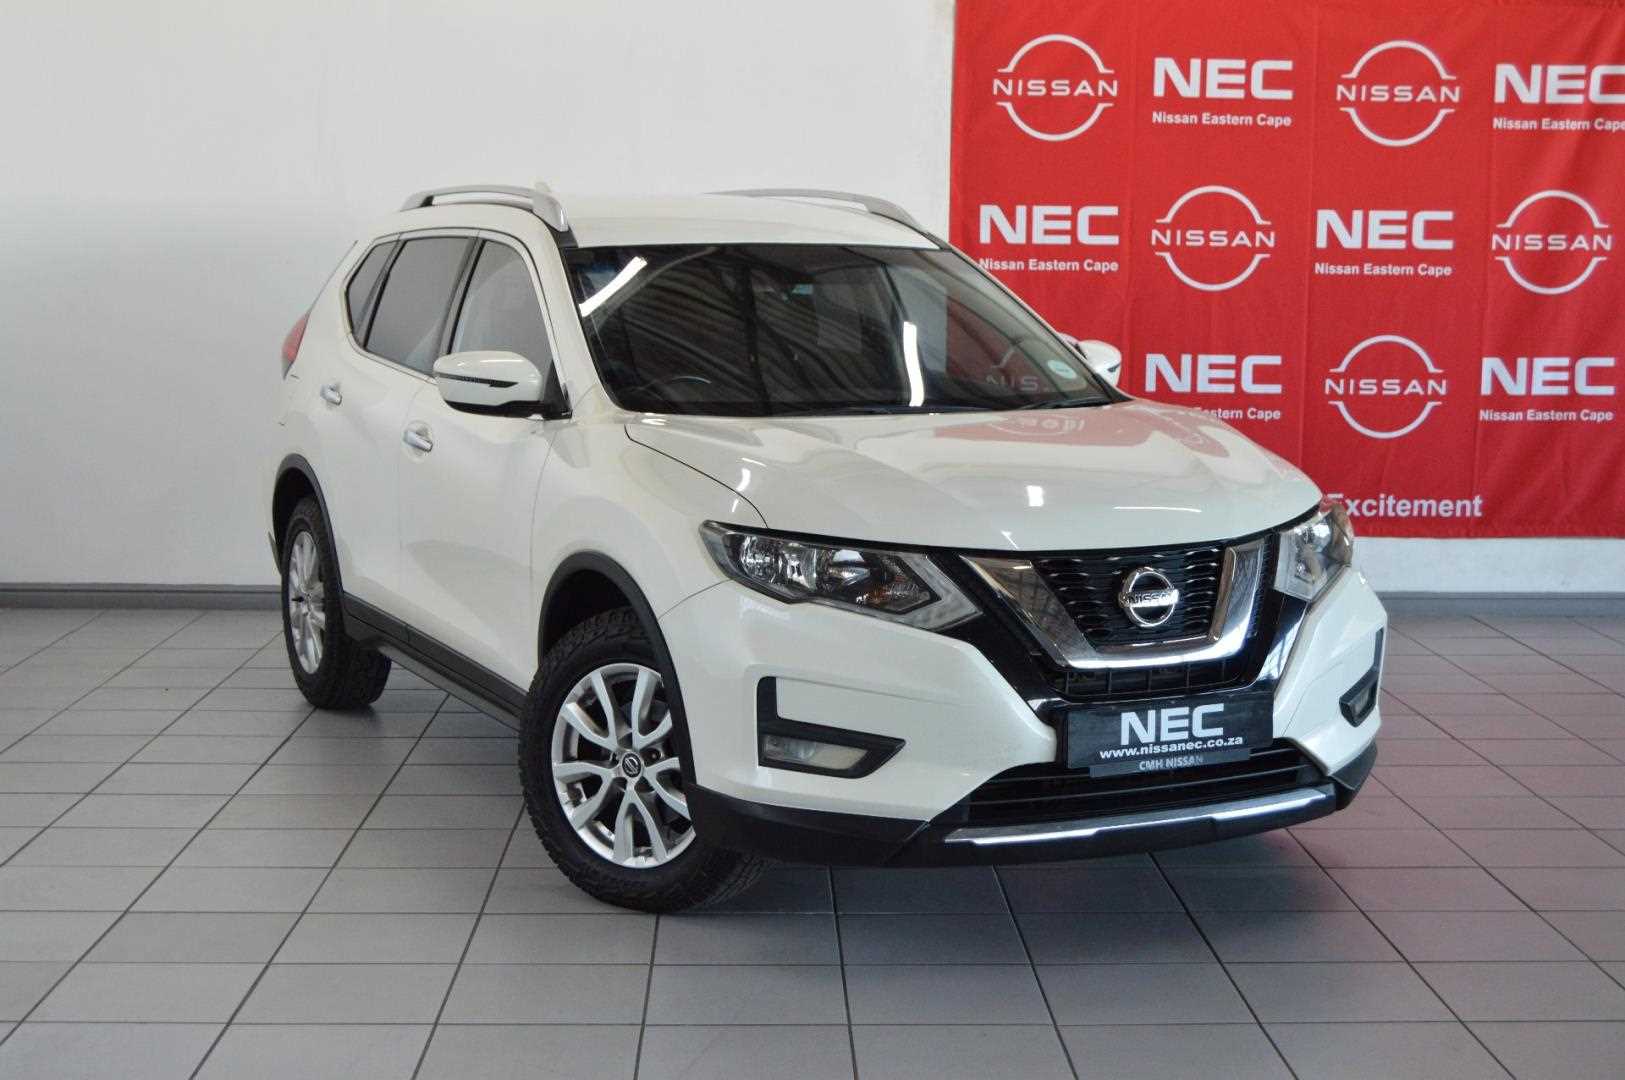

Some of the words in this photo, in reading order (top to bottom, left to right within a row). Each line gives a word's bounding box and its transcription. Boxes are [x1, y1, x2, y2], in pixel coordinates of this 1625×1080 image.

[992, 78, 1118, 97] NISSAN
[1153, 56, 1294, 101] NEC
[1494, 63, 1625, 105] NEC
[1336, 84, 1461, 103] NISSAN
[1152, 111, 1198, 125] Nissan
[1202, 112, 1253, 126] Eastern
[1257, 113, 1292, 129] Cape
[1493, 117, 1538, 130] Nissan
[1542, 118, 1590, 131] Eastern
[1594, 118, 1625, 132] Cape
[979, 204, 1120, 246] NEC
[1315, 208, 1454, 250] NEC
[1151, 228, 1275, 248] NISSAN
[1491, 233, 1612, 251] NISSAN
[979, 258, 1024, 271] Nissan
[1029, 258, 1080, 271] Eastern
[1084, 258, 1119, 274] Cape
[1315, 262, 1360, 275] Nissan
[1364, 262, 1414, 276] Eastern
[1418, 263, 1453, 278] Cape
[1145, 353, 1283, 394] NEC
[1480, 356, 1616, 396] NEC
[1325, 378, 1447, 396] NISSAN
[1191, 407, 1243, 420] astern
[1247, 407, 1281, 422] Cape
[1479, 409, 1524, 421] Nissan
[1527, 409, 1577, 421] Eastern
[1580, 409, 1613, 424] Cape
[1327, 493, 1483, 517] xcitement
[1120, 703, 1225, 746] NEC
[1099, 736, 1243, 759] www.nissanec.co.za
[1138, 758, 1164, 771] CMH
[1165, 754, 1204, 770] NISSAN
